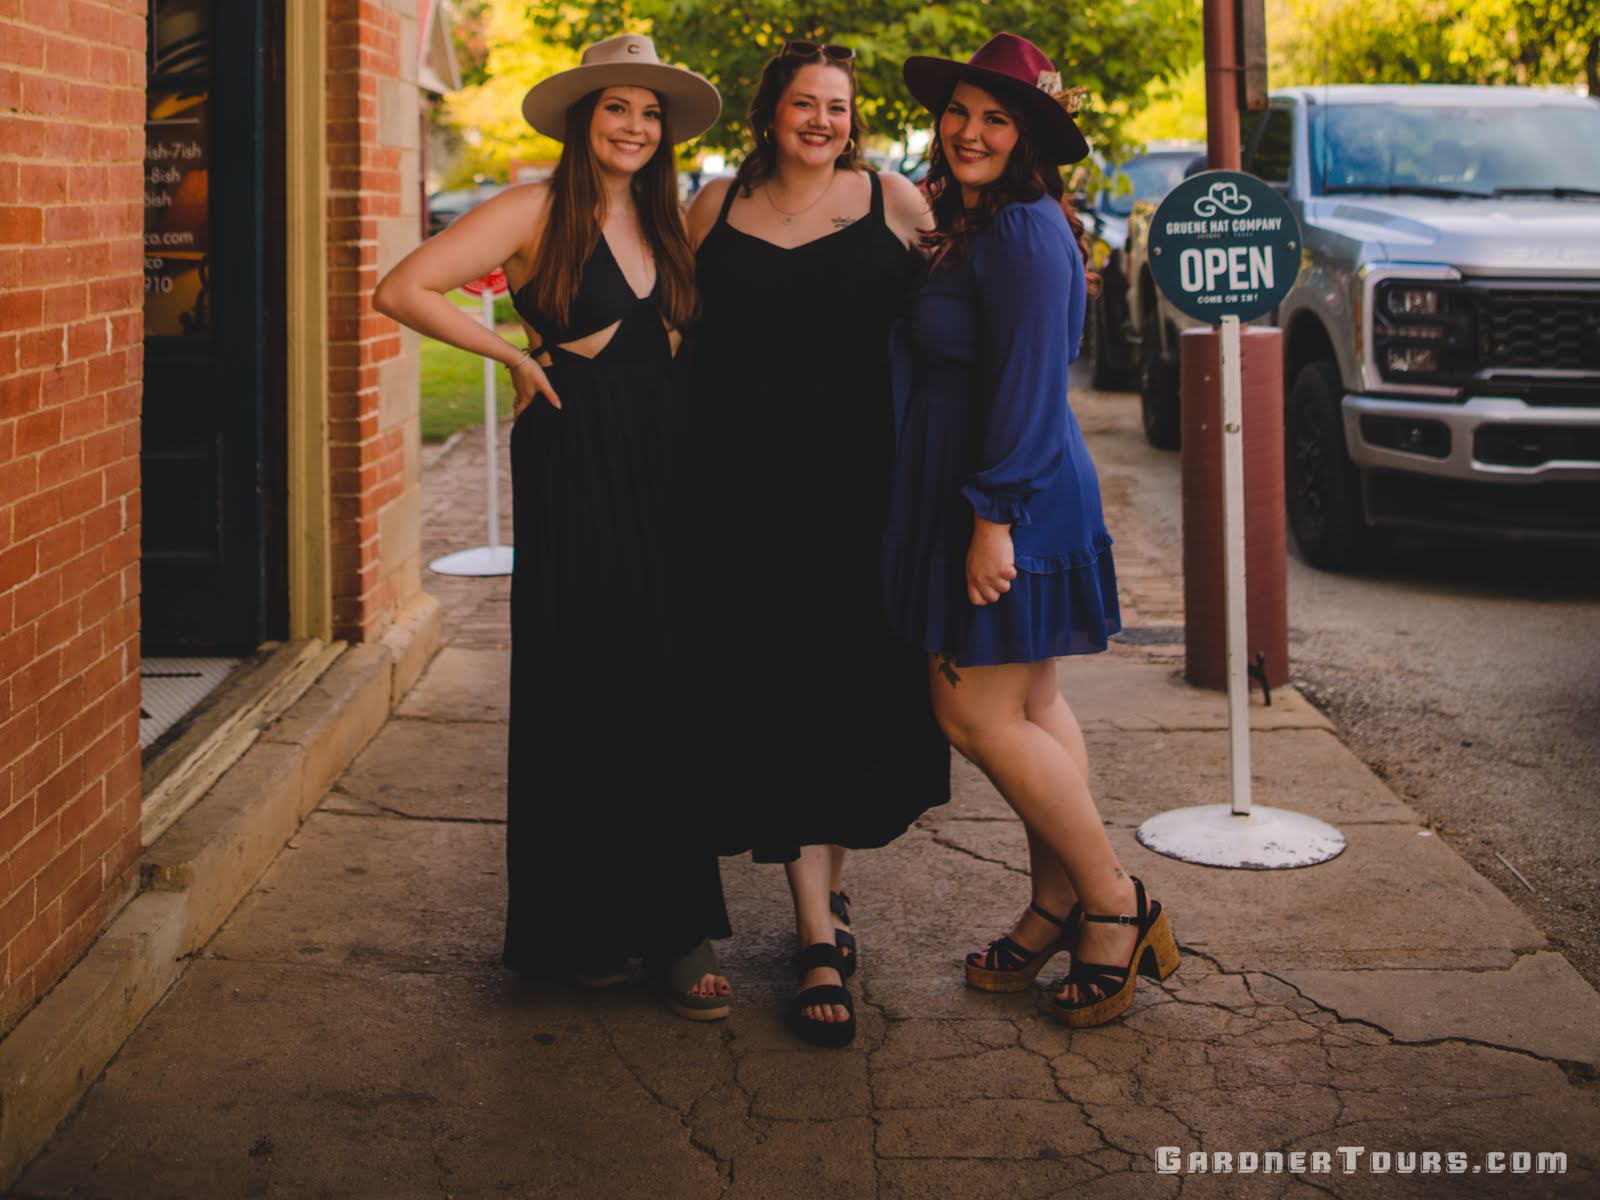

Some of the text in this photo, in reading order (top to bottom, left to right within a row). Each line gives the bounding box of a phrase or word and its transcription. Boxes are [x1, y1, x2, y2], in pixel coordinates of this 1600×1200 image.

[1166, 217, 1282, 235] GRUENE HAT COMPANY
[1180, 245, 1275, 293] OPEN
